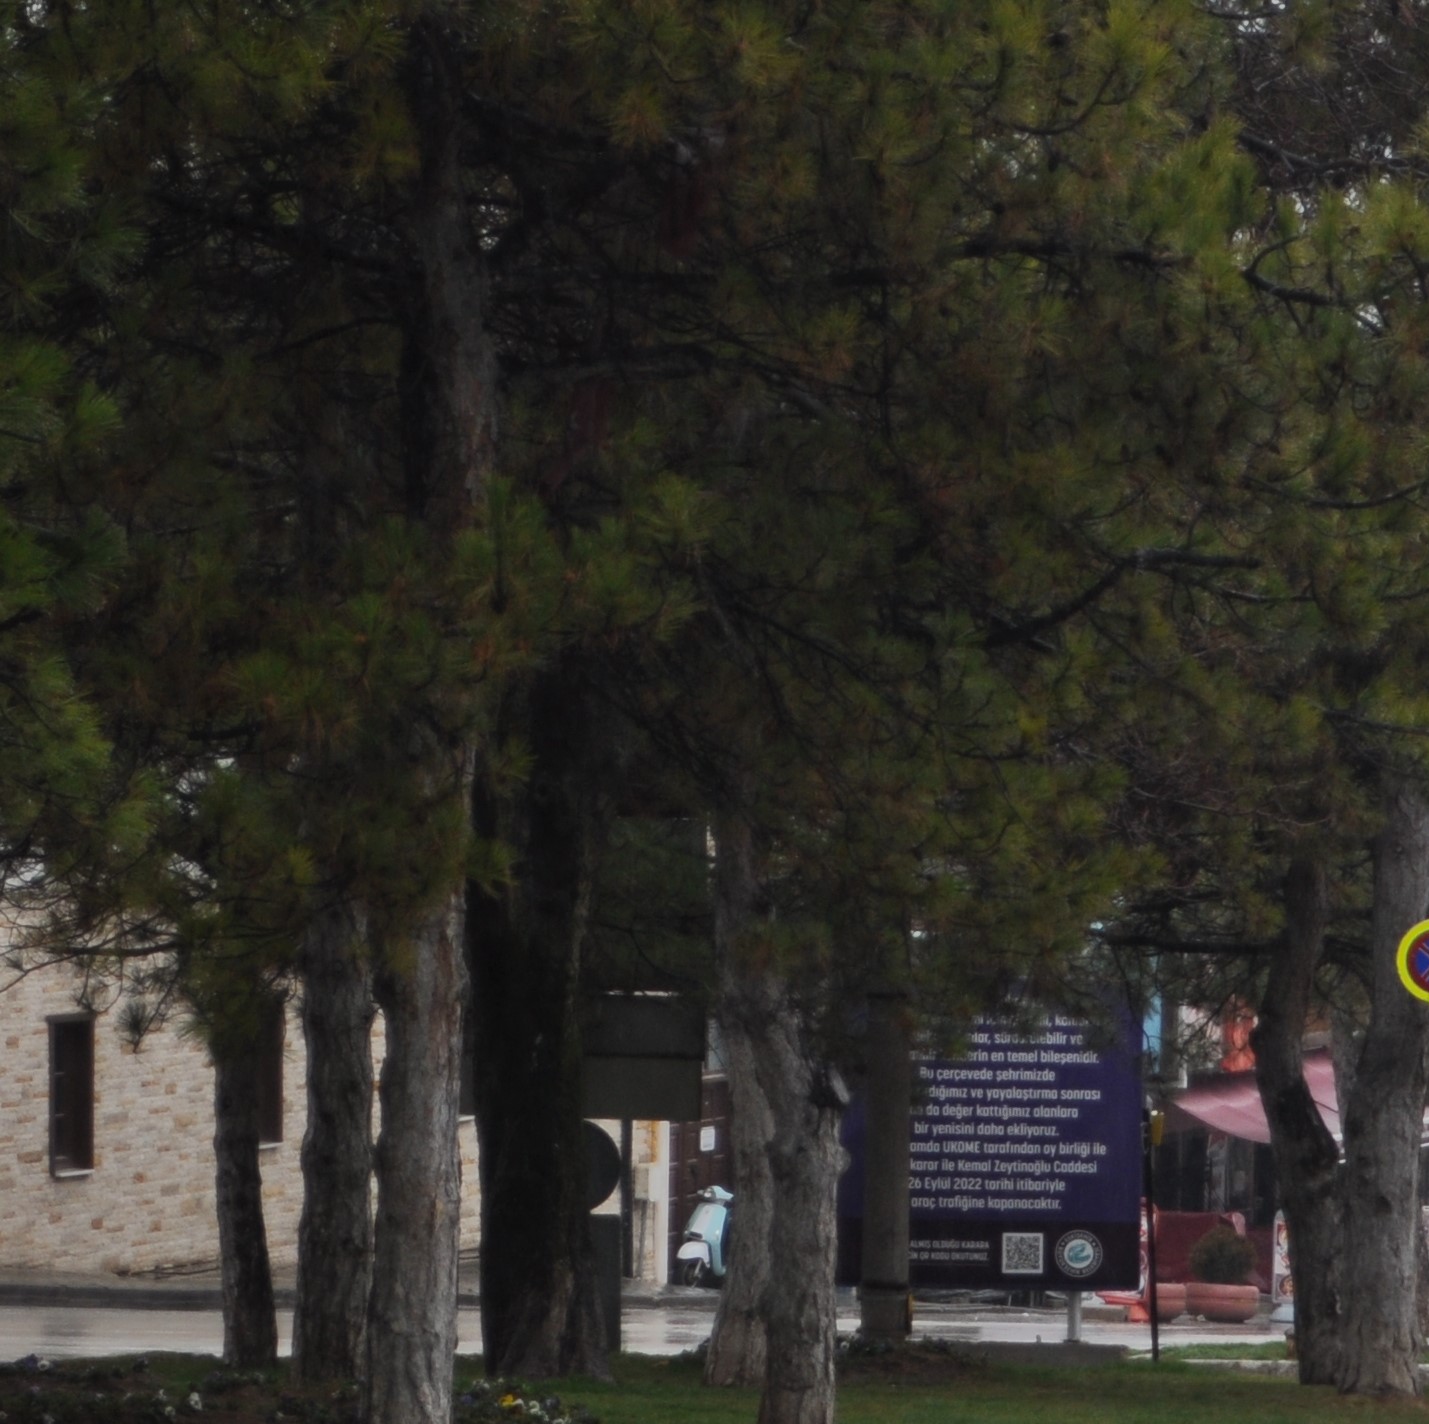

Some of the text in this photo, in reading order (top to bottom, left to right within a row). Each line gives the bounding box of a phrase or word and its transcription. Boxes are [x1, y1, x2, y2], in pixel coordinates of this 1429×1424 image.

[991, 1052, 1004, 1062] en
[1007, 1050, 1037, 1063] temel
[1041, 1050, 1100, 1065] bileşenidir.
[920, 1067, 1056, 1082] Bu çerçevede şehrimizde
[970, 1089, 983, 1099] ve
[986, 1087, 1058, 1102] yayalaştırma
[1060, 1089, 1101, 1100] sonrası
[926, 1103, 940, 1115] da
[942, 1103, 973, 1119] değer
[976, 1103, 1031, 1119] kattığımız
[1033, 1105, 1078, 1118] alanlara
[914, 1121, 1059, 1138] bir yenisini daha ekliyoruz.
[943, 1141, 981, 1153] UKOME
[983, 1142, 1040, 1154] tarafından
[1043, 1145, 1056, 1157] oy
[1059, 1143, 1090, 1157] birliği
[1092, 1143, 1107, 1155] ile
[910, 1159, 1097, 1176] karar ile Kemal Zeytinoğlu Caddesi
[908, 1177, 1066, 1194] 26 Eylül 2022 tarihi itibariyle
[911, 1196, 1062, 1211] araç trafiğine kapanacaktır.
[931, 1252, 950, 1260] KODU
